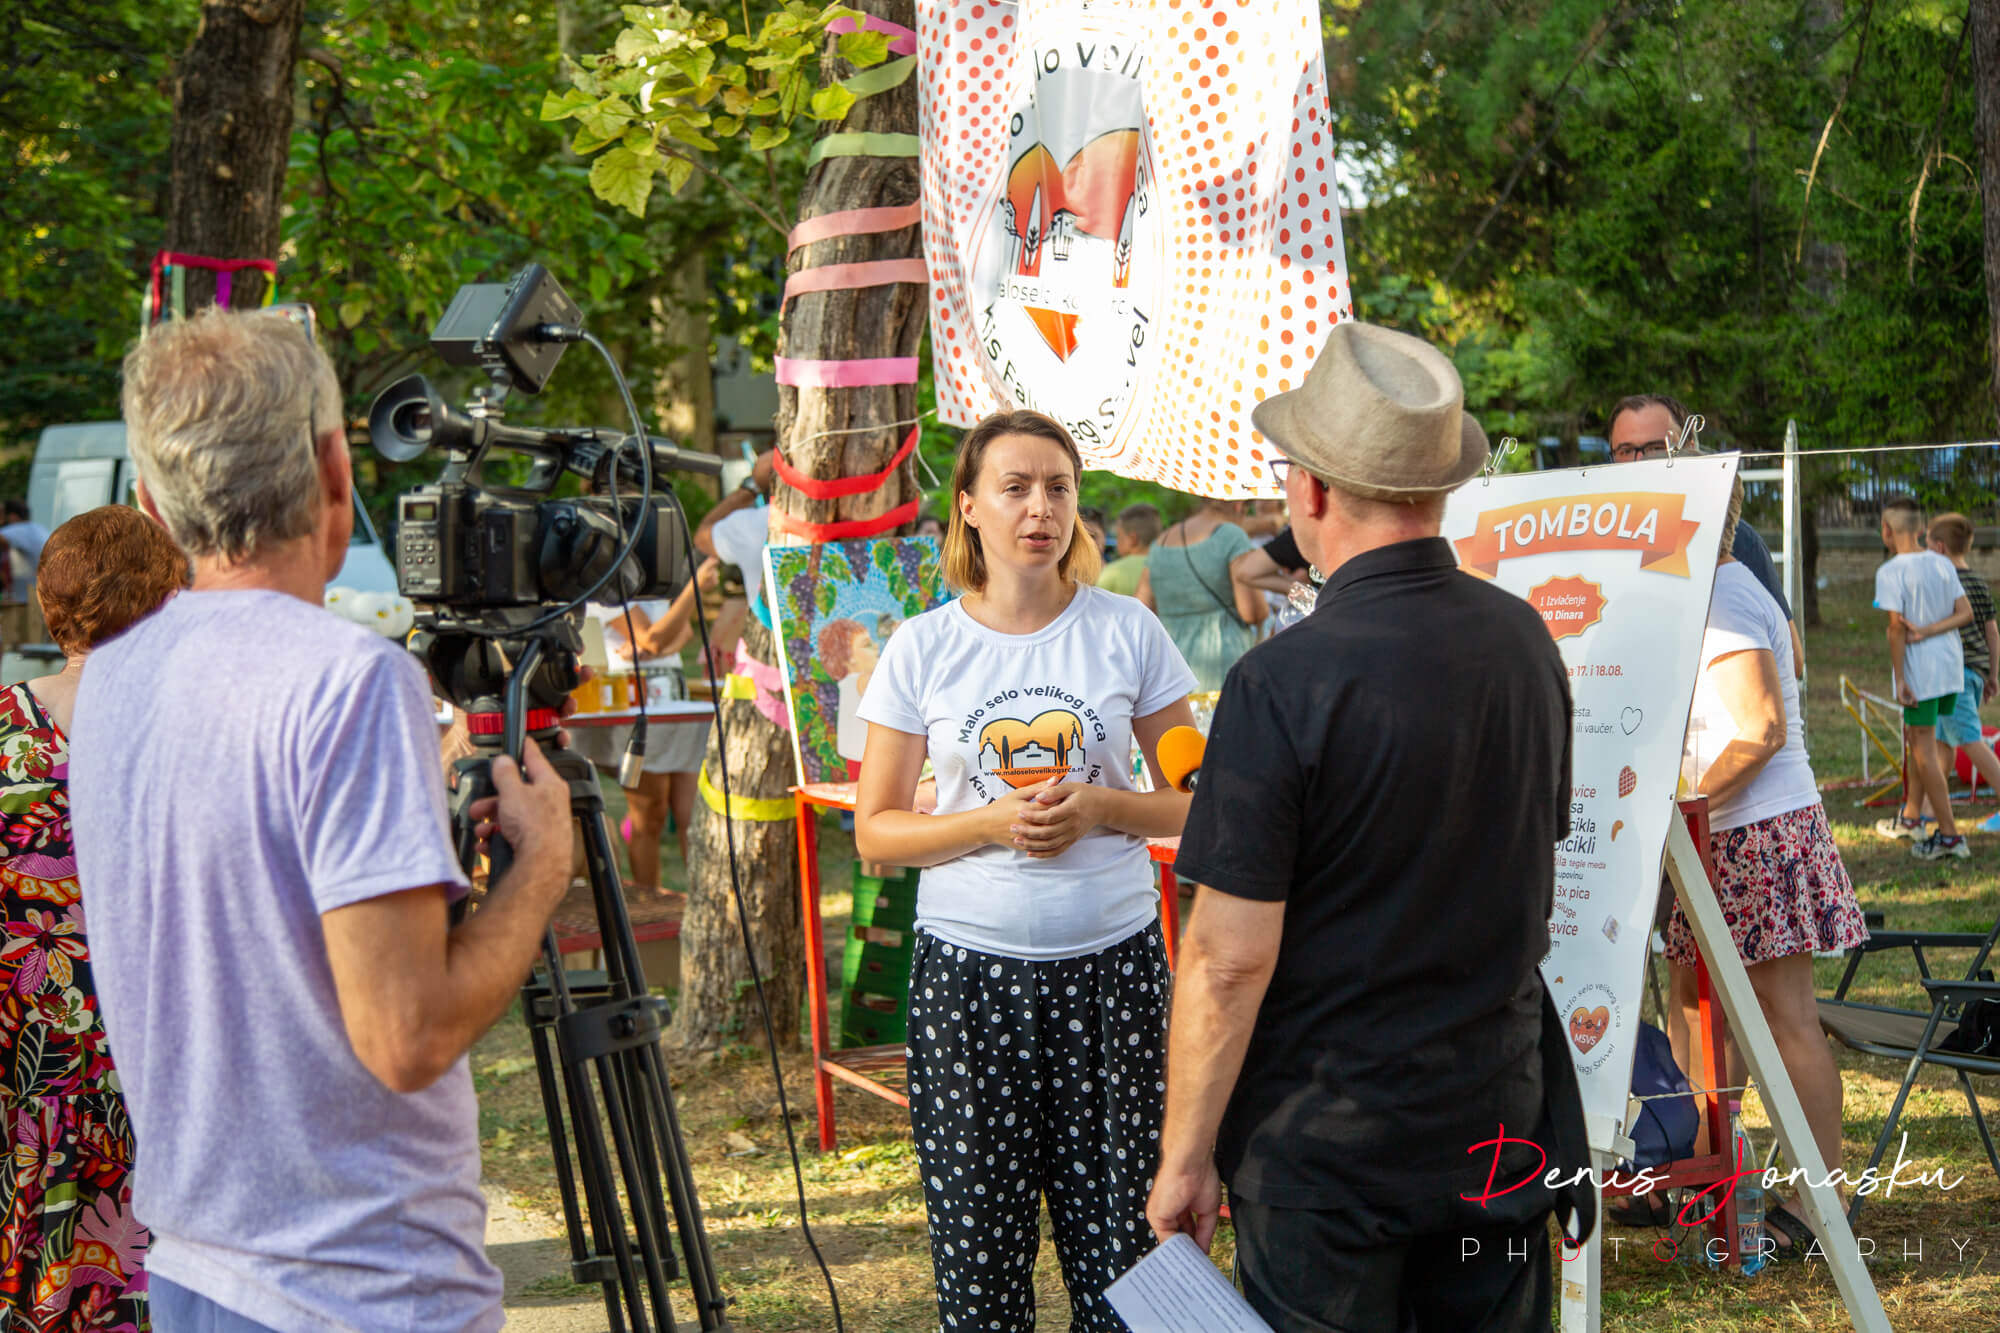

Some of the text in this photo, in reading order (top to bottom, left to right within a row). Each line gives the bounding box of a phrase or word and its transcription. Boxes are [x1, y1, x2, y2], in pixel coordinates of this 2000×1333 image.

[1493, 502, 1659, 553] TOMBOLA
[1555, 609, 1584, 620] Dinara
[1577, 665, 1588, 677] 17.
[1590, 664, 1594, 677] i
[1595, 665, 1624, 677] 18.08.
[957, 685, 1107, 744] Malo selo velikog srca
[1585, 721, 1615, 735] vaučer.
[983, 766, 1085, 777] www.maloselovelikogsrca.rs
[968, 775, 988, 799] Kis
[1554, 870, 1584, 880] upovinu
[1555, 884, 1591, 901] 3x pica
[1578, 983, 1594, 997] selo
[1573, 1033, 1597, 1046] MSVS
